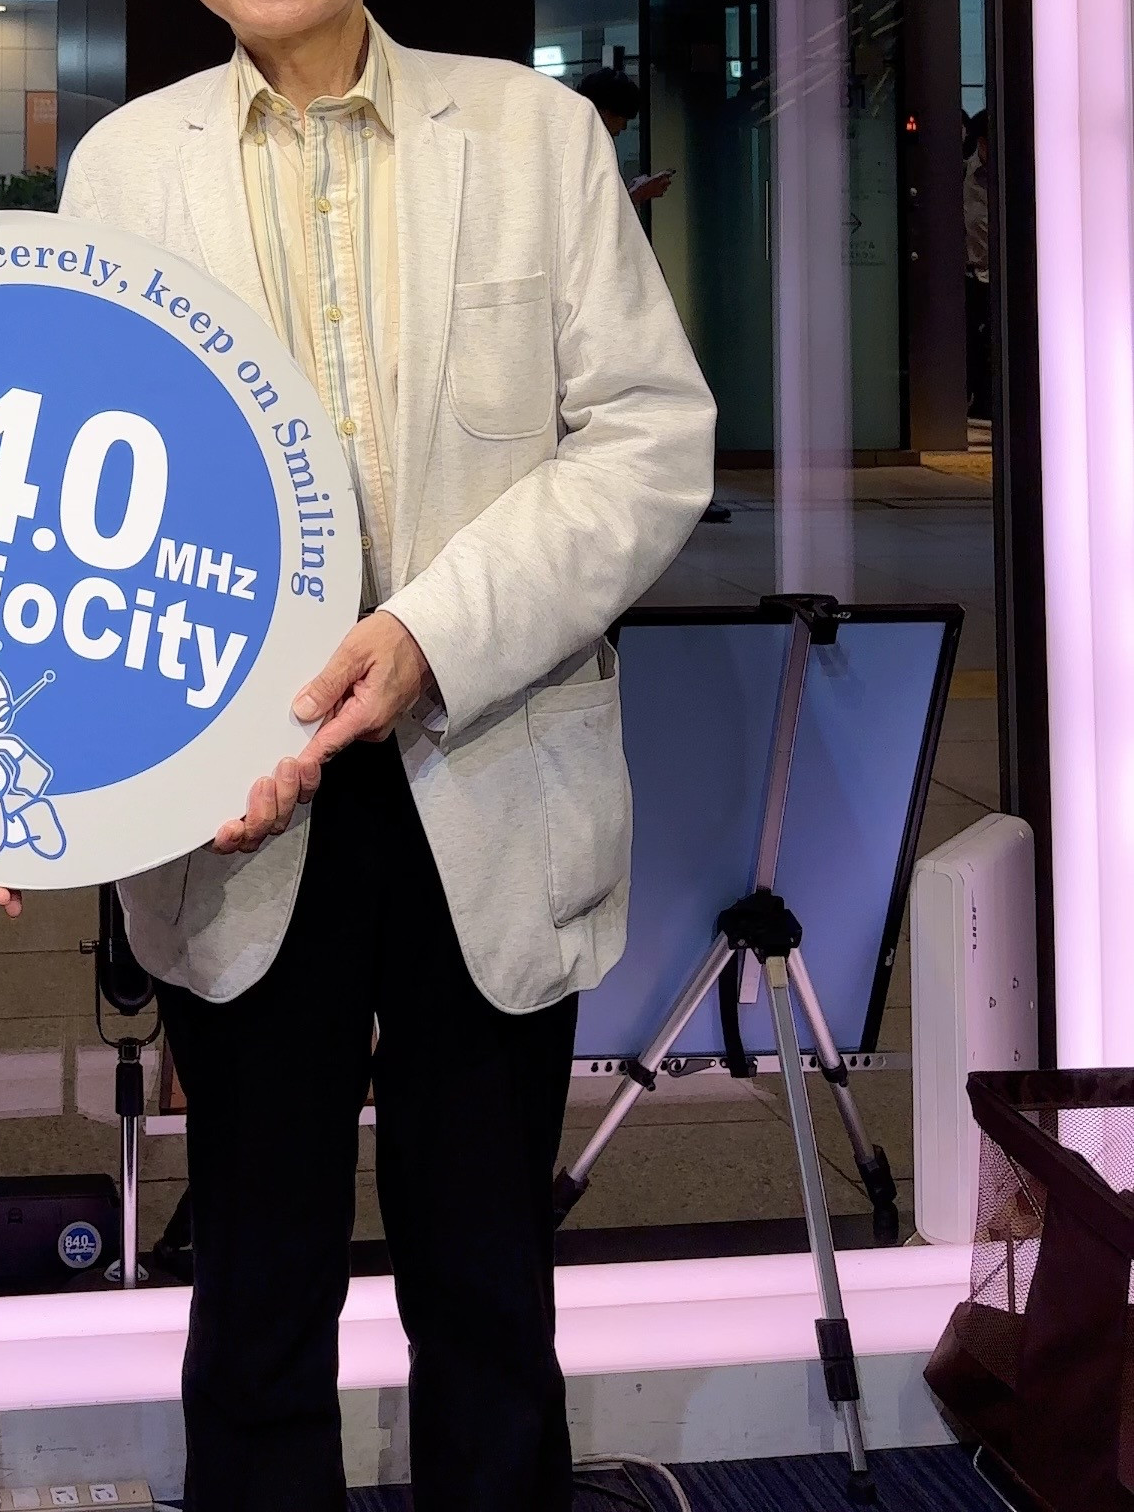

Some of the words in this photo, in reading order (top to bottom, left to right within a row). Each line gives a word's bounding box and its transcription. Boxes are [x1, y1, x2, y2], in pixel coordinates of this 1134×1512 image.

[140, 268, 235, 355] keep
[236, 359, 280, 413] on
[271, 417, 336, 604] Smiling
[154, 536, 259, 601] MHz
